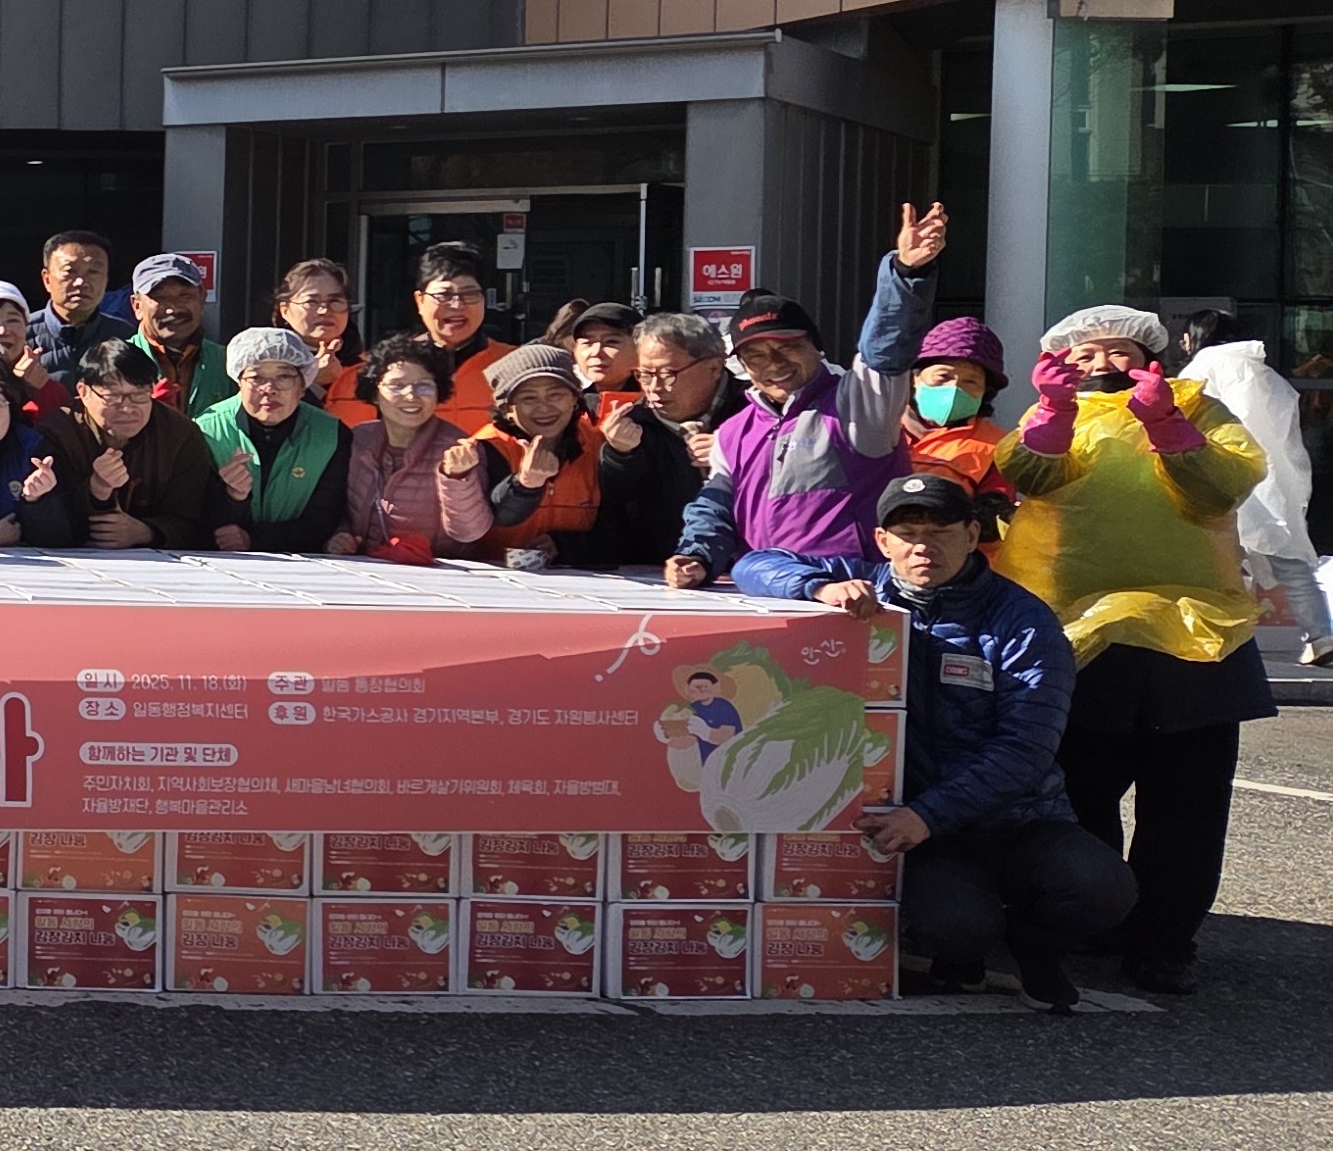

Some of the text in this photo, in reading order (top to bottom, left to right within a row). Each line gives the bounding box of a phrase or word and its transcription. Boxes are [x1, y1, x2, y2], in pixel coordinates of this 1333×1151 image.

[702, 263, 742, 279] 에스원
[133, 702, 249, 719] 일동행정복지센터
[323, 706, 408, 723] 한국가스공사
[508, 708, 550, 725] 경기도
[554, 709, 639, 726] 자원봉사센터
[88, 745, 231, 763] 함께하는 기관 및 단체
[30, 832, 86, 848] 김장 나눔
[35, 930, 115, 946] 김장김치 나눔
[181, 932, 238, 949] 김장 나눔
[766, 942, 824, 957] 김장 나눔
